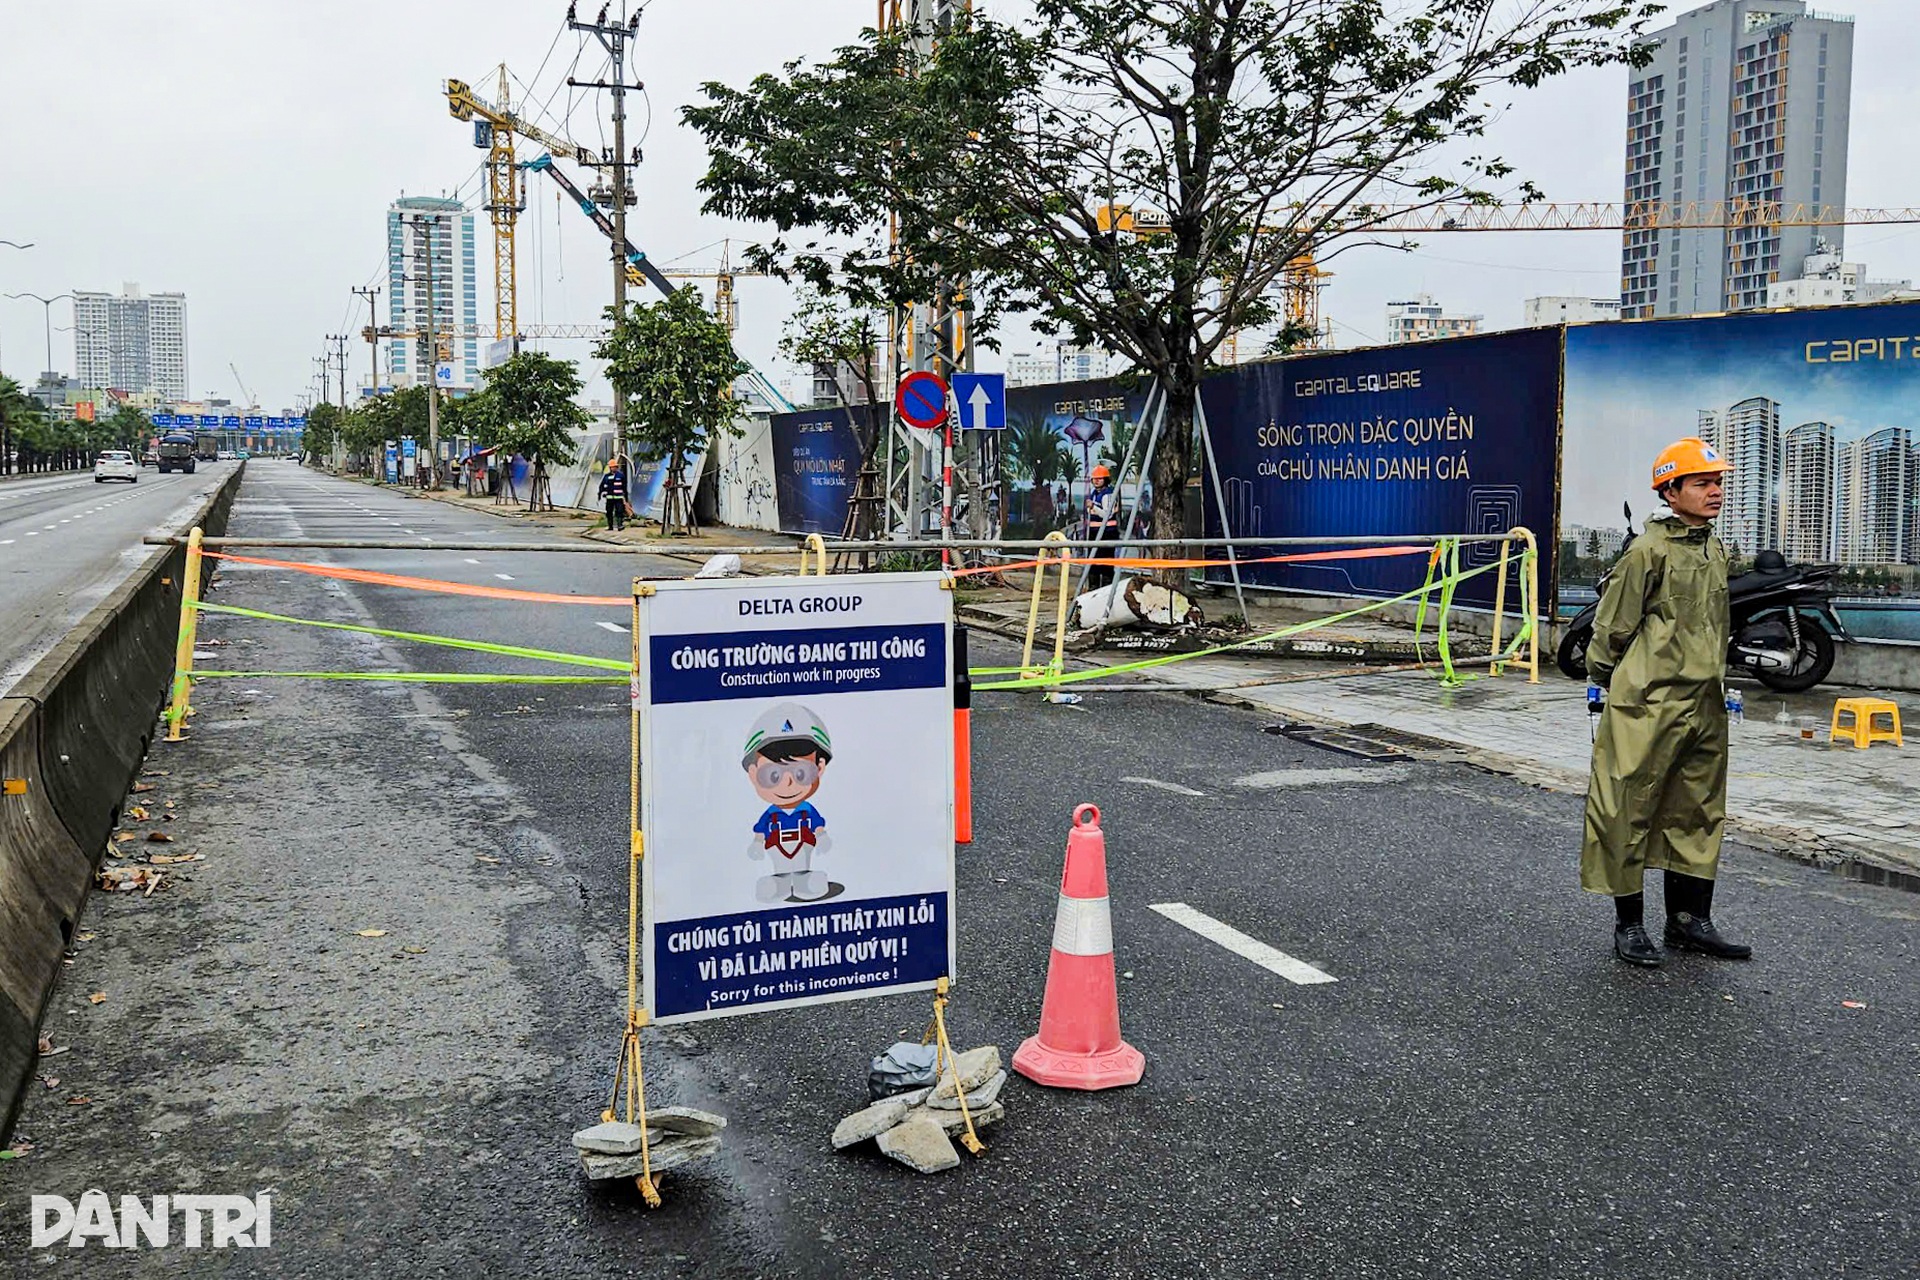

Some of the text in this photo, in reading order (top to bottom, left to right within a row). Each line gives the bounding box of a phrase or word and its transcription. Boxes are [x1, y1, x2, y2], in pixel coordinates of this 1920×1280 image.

[1806, 337, 1920, 363] CAPIT
[1295, 369, 1422, 397] CAPITAL SQUARE
[1257, 407, 1474, 450] SỐNG TRỌN ĐẶC QUYỀN
[1279, 452, 1314, 481] CHỦ
[1318, 453, 1369, 480] NHÂN
[1375, 457, 1430, 480] DANH
[1435, 450, 1470, 479] GIÁ
[1655, 463, 1674, 476] DELTA
[738, 595, 863, 616] DELTA GROUP
[671, 636, 926, 670] CÔNG TRƯỜNG ĐANG THI CÔNG
[721, 666, 881, 687] Construction work in progress
[668, 898, 935, 953] CHÚNG TÔI THÀNH THẬT XIN LỖI
[699, 951, 717, 982] VÌ
[720, 956, 746, 979] ĐÃ
[749, 950, 787, 976] LÀM
[790, 941, 842, 971] PHIỀN
[845, 938, 879, 964] QUÝ
[880, 938, 898, 962] VỊ
[710, 987, 750, 1004] Sorry
[753, 983, 776, 997] for
[779, 979, 806, 993] this
[809, 970, 890, 990] inconvience
